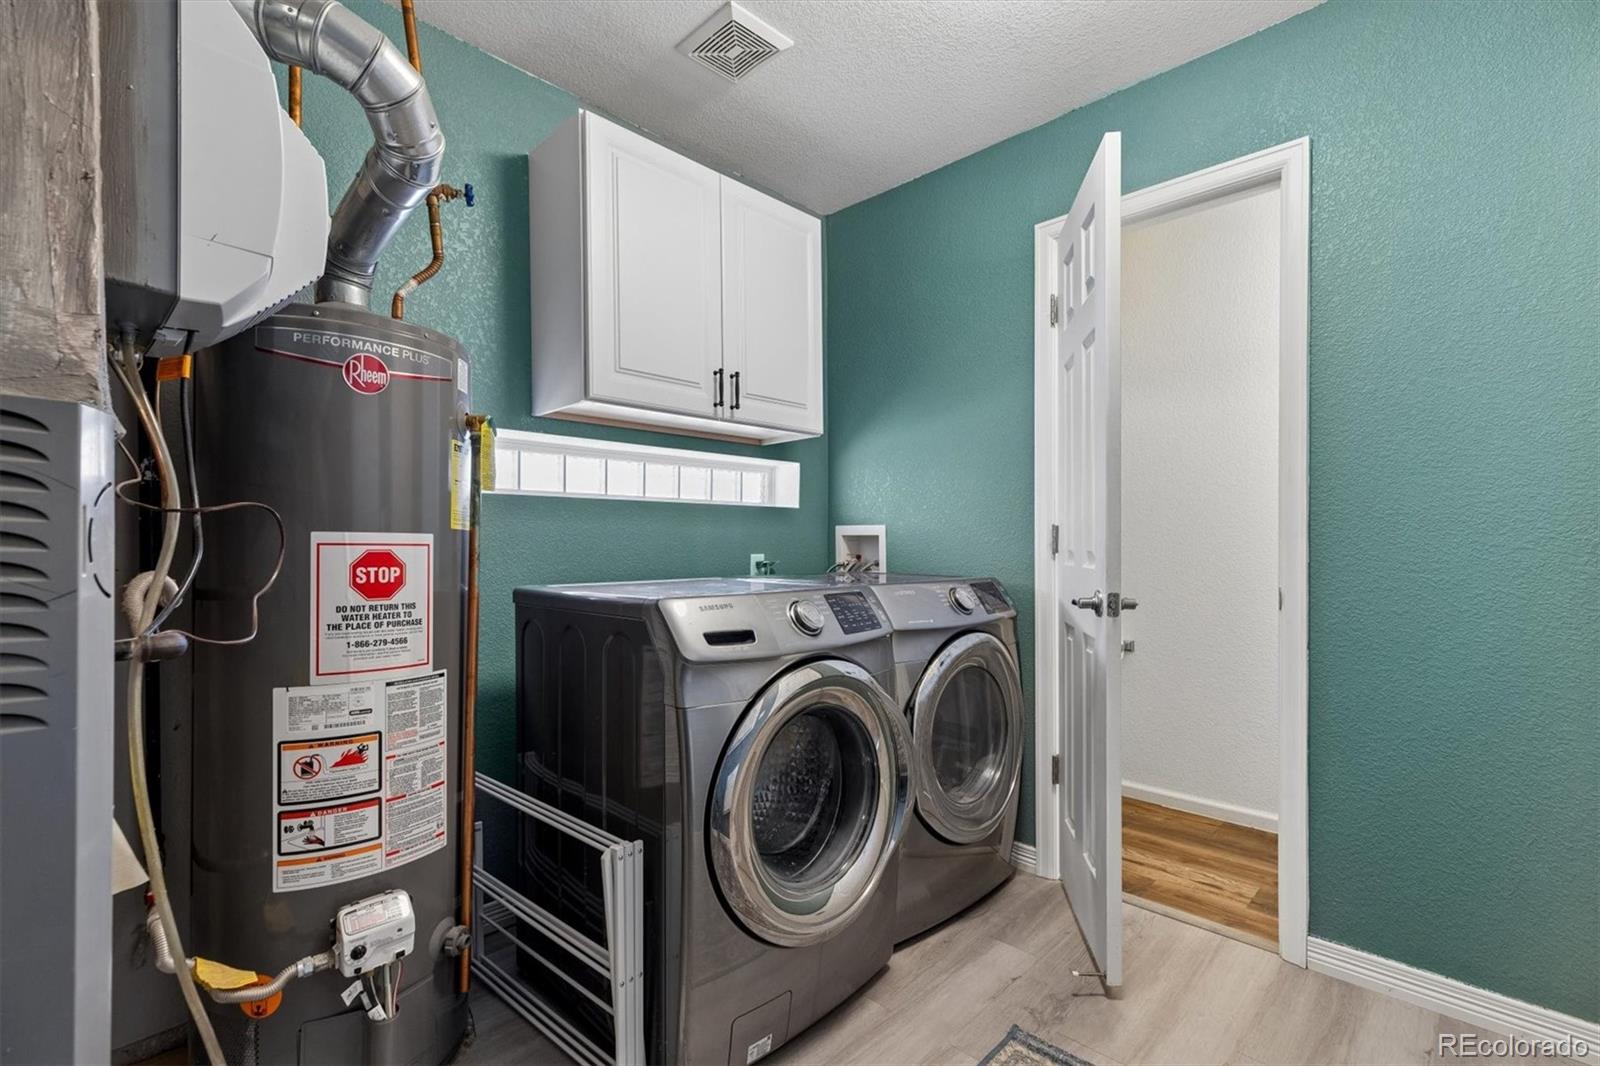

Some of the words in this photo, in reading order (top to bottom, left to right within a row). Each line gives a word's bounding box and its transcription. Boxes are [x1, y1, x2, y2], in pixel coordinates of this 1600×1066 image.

[293, 332, 399, 357] PERFORMANCE
[402, 350, 430, 365] PLUS
[349, 354, 387, 388] Rheem
[355, 566, 401, 584] STOP
[335, 605, 348, 614] DO
[349, 604, 366, 613] NOT
[368, 603, 399, 612] RETURN
[401, 602, 417, 610] THIS
[698, 602, 734, 612] SAMSUNG
[341, 613, 370, 622] WATER
[372, 611, 401, 620] HEATER
[403, 610, 413, 618] TO
[326, 623, 343, 632] THE
[345, 621, 370, 631] PLACE
[373, 620, 384, 629] OF
[386, 618, 423, 628] PURCHASE
[346, 637, 408, 649] 1-866-279-4566
[317, 739, 354, 748] WARNING
[317, 807, 348, 816] DANGER
